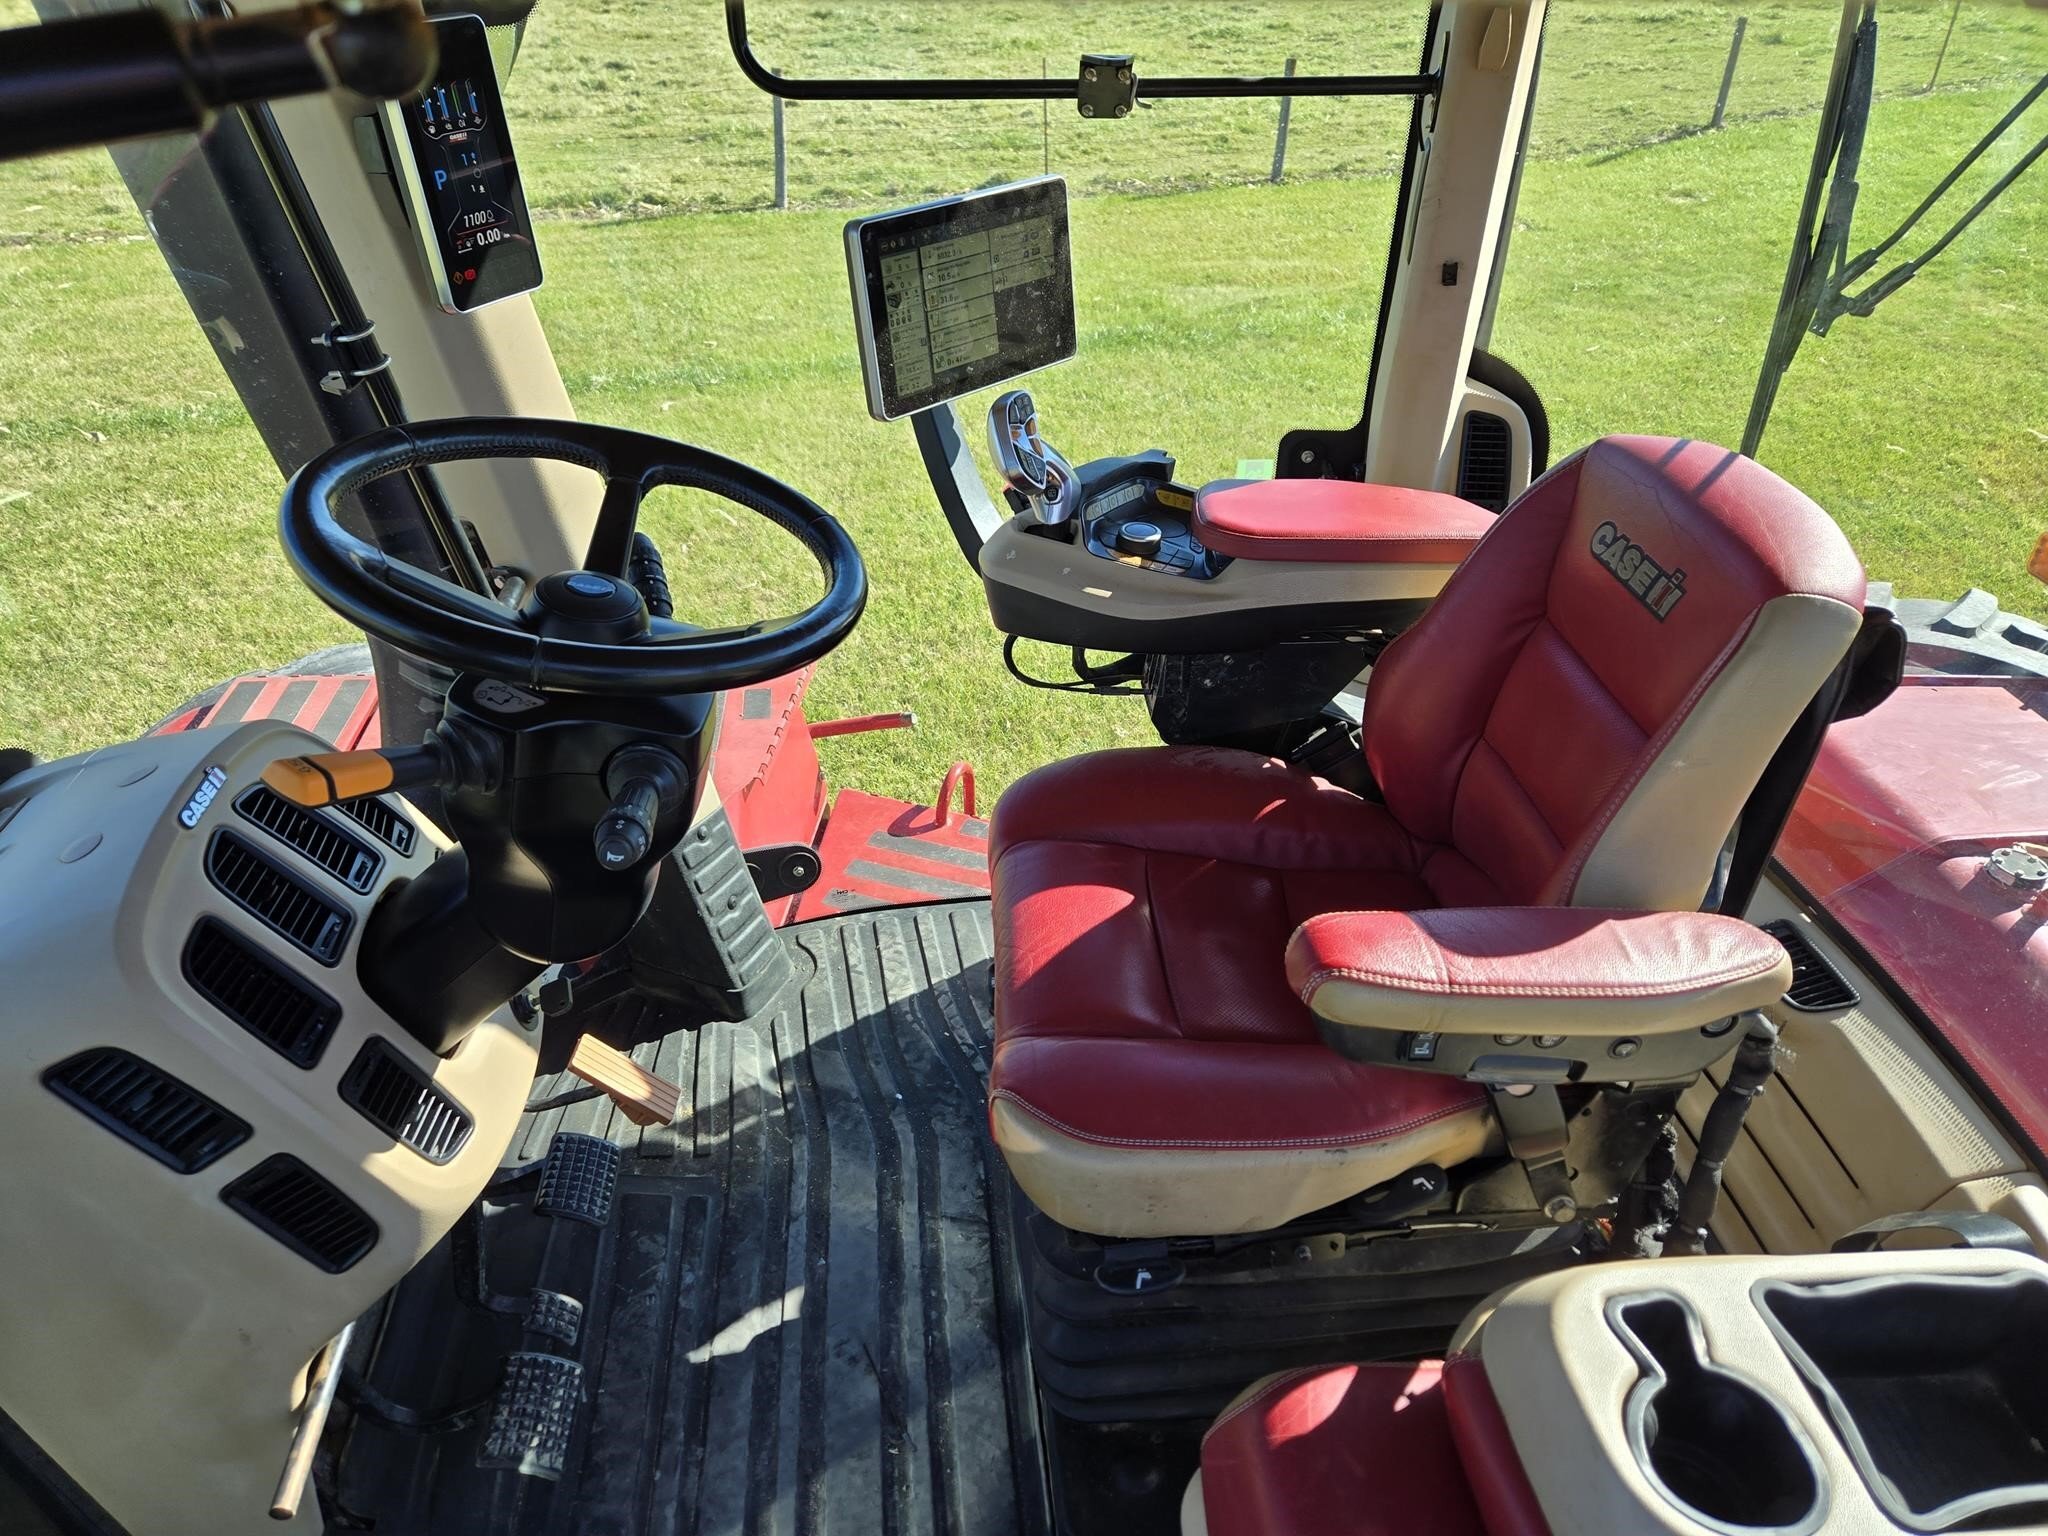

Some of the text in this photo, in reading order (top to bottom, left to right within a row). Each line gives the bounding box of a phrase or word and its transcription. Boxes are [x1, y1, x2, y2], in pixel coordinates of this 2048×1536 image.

[434, 169, 447, 190] P
[464, 210, 487, 228] 1100
[476, 228, 501, 246] 0.00
